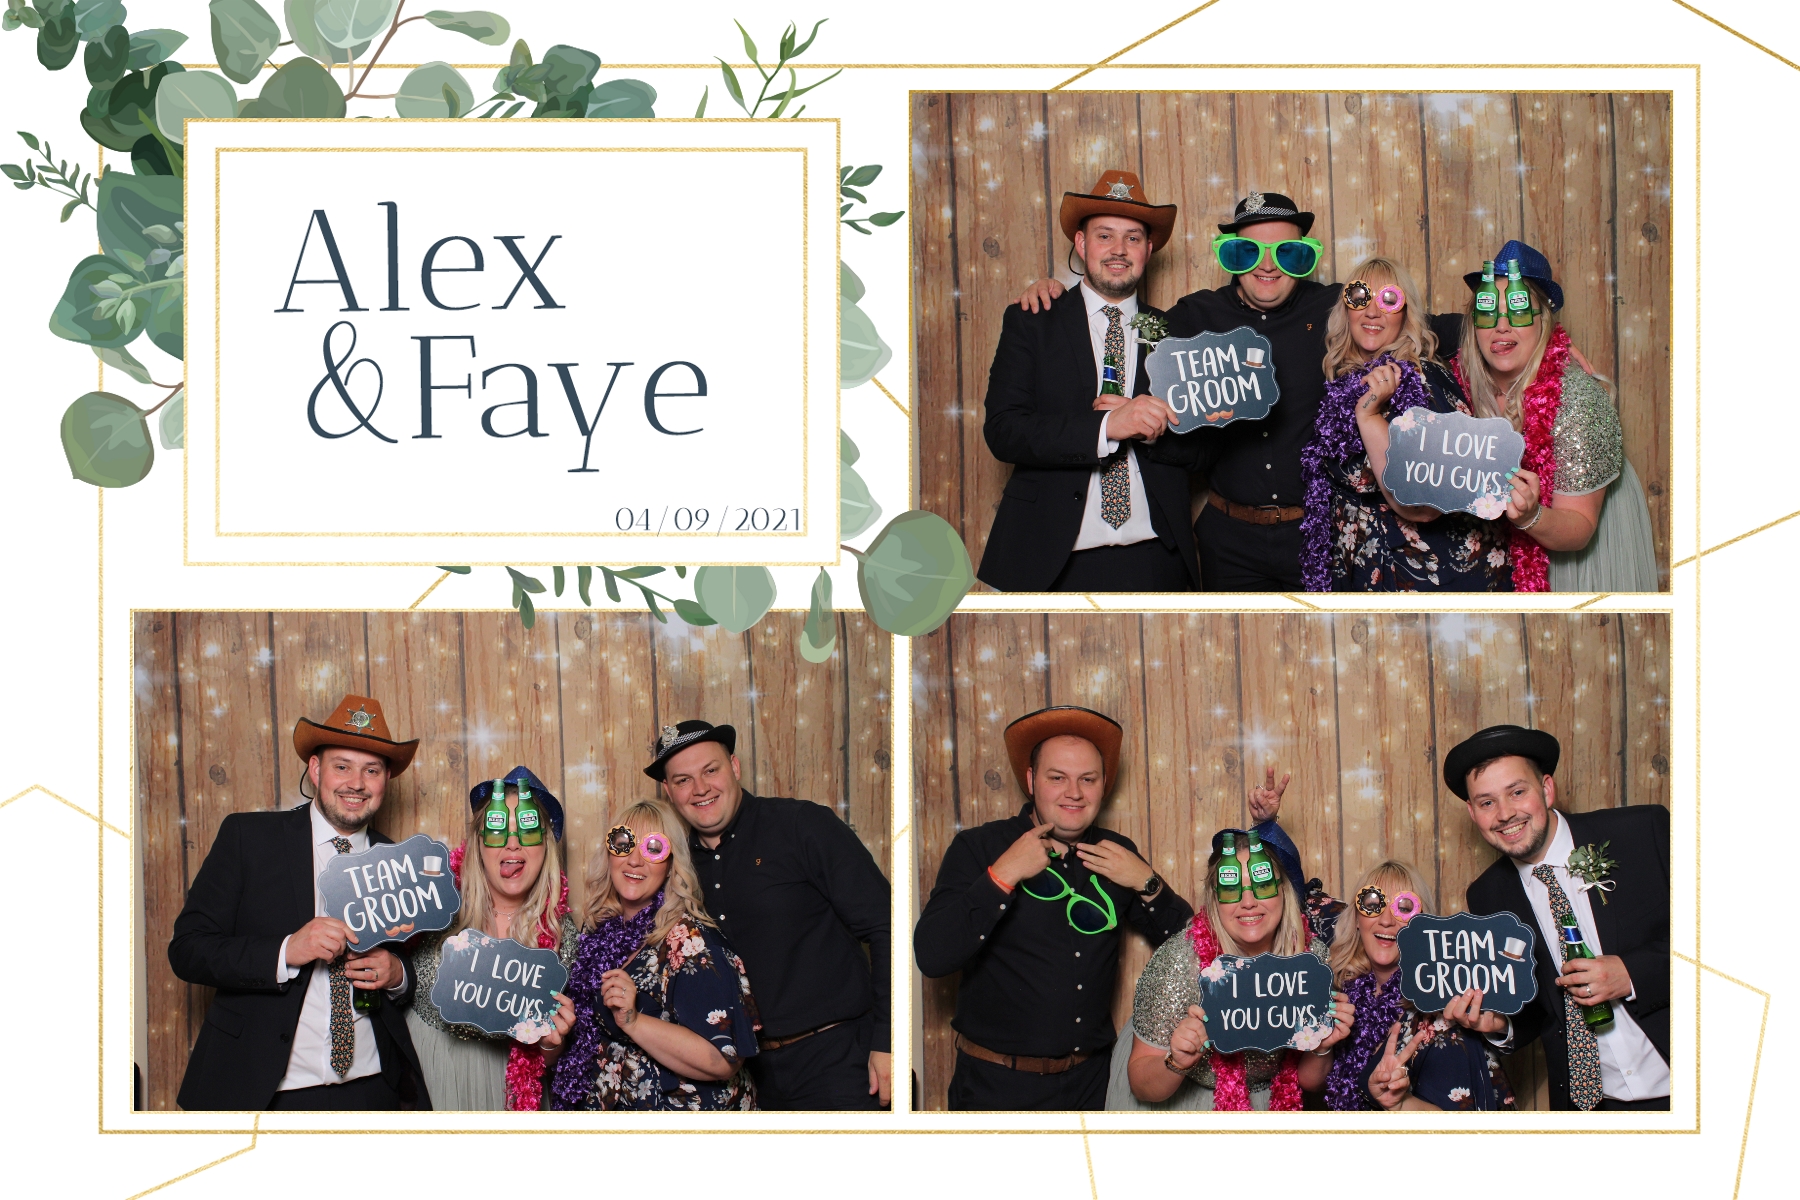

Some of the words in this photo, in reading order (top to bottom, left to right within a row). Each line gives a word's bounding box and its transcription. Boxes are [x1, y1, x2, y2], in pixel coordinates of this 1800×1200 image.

[1170, 343, 1240, 381] TEAM
[1167, 371, 1262, 416] GROOM
[1419, 426, 1427, 451] I
[1442, 429, 1499, 461] LOVE
[1405, 460, 1444, 487] YOU
[1450, 466, 1501, 496] GUYS
[343, 854, 418, 898] TEAM
[343, 881, 443, 933] GROOM
[1422, 929, 1496, 962] TEAM
[470, 948, 479, 973] I
[491, 954, 546, 989] LOVE
[1232, 973, 1238, 998] I
[1254, 970, 1309, 997] LOVE
[1414, 962, 1516, 999] GROOM
[453, 979, 492, 1008] YOU
[495, 990, 544, 1022] GUYS
[1220, 1007, 1260, 1031] YOU
[1267, 1004, 1318, 1029] GUYS
